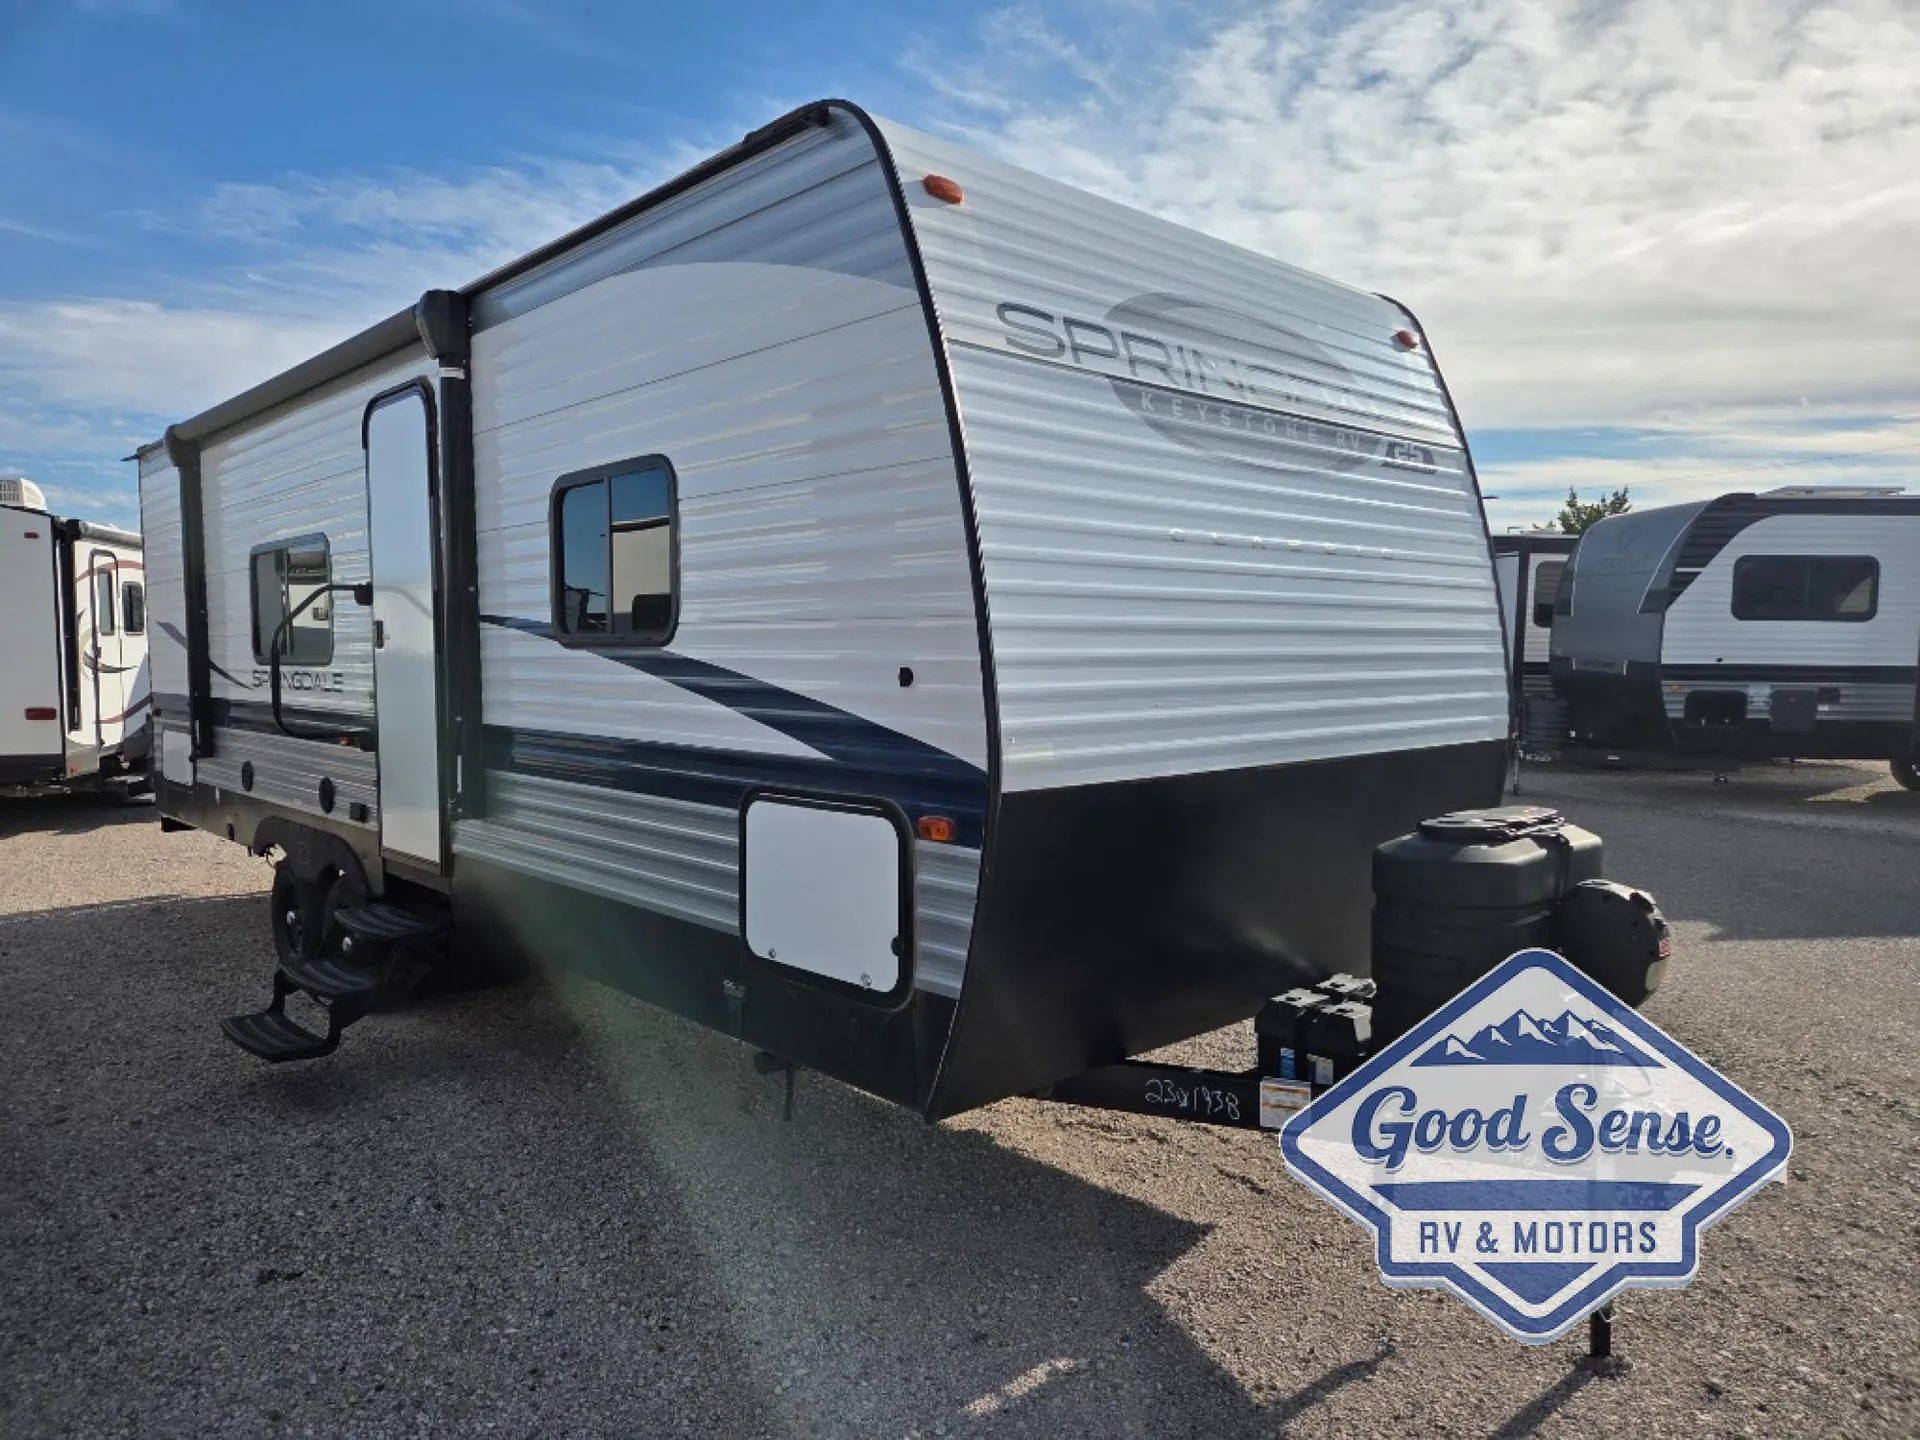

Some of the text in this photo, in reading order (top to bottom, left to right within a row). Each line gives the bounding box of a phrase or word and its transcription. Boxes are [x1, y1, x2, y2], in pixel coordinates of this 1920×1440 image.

[1140, 391, 1361, 450] KEYSTONE RV
[252, 668, 344, 694] SPNGDALE
